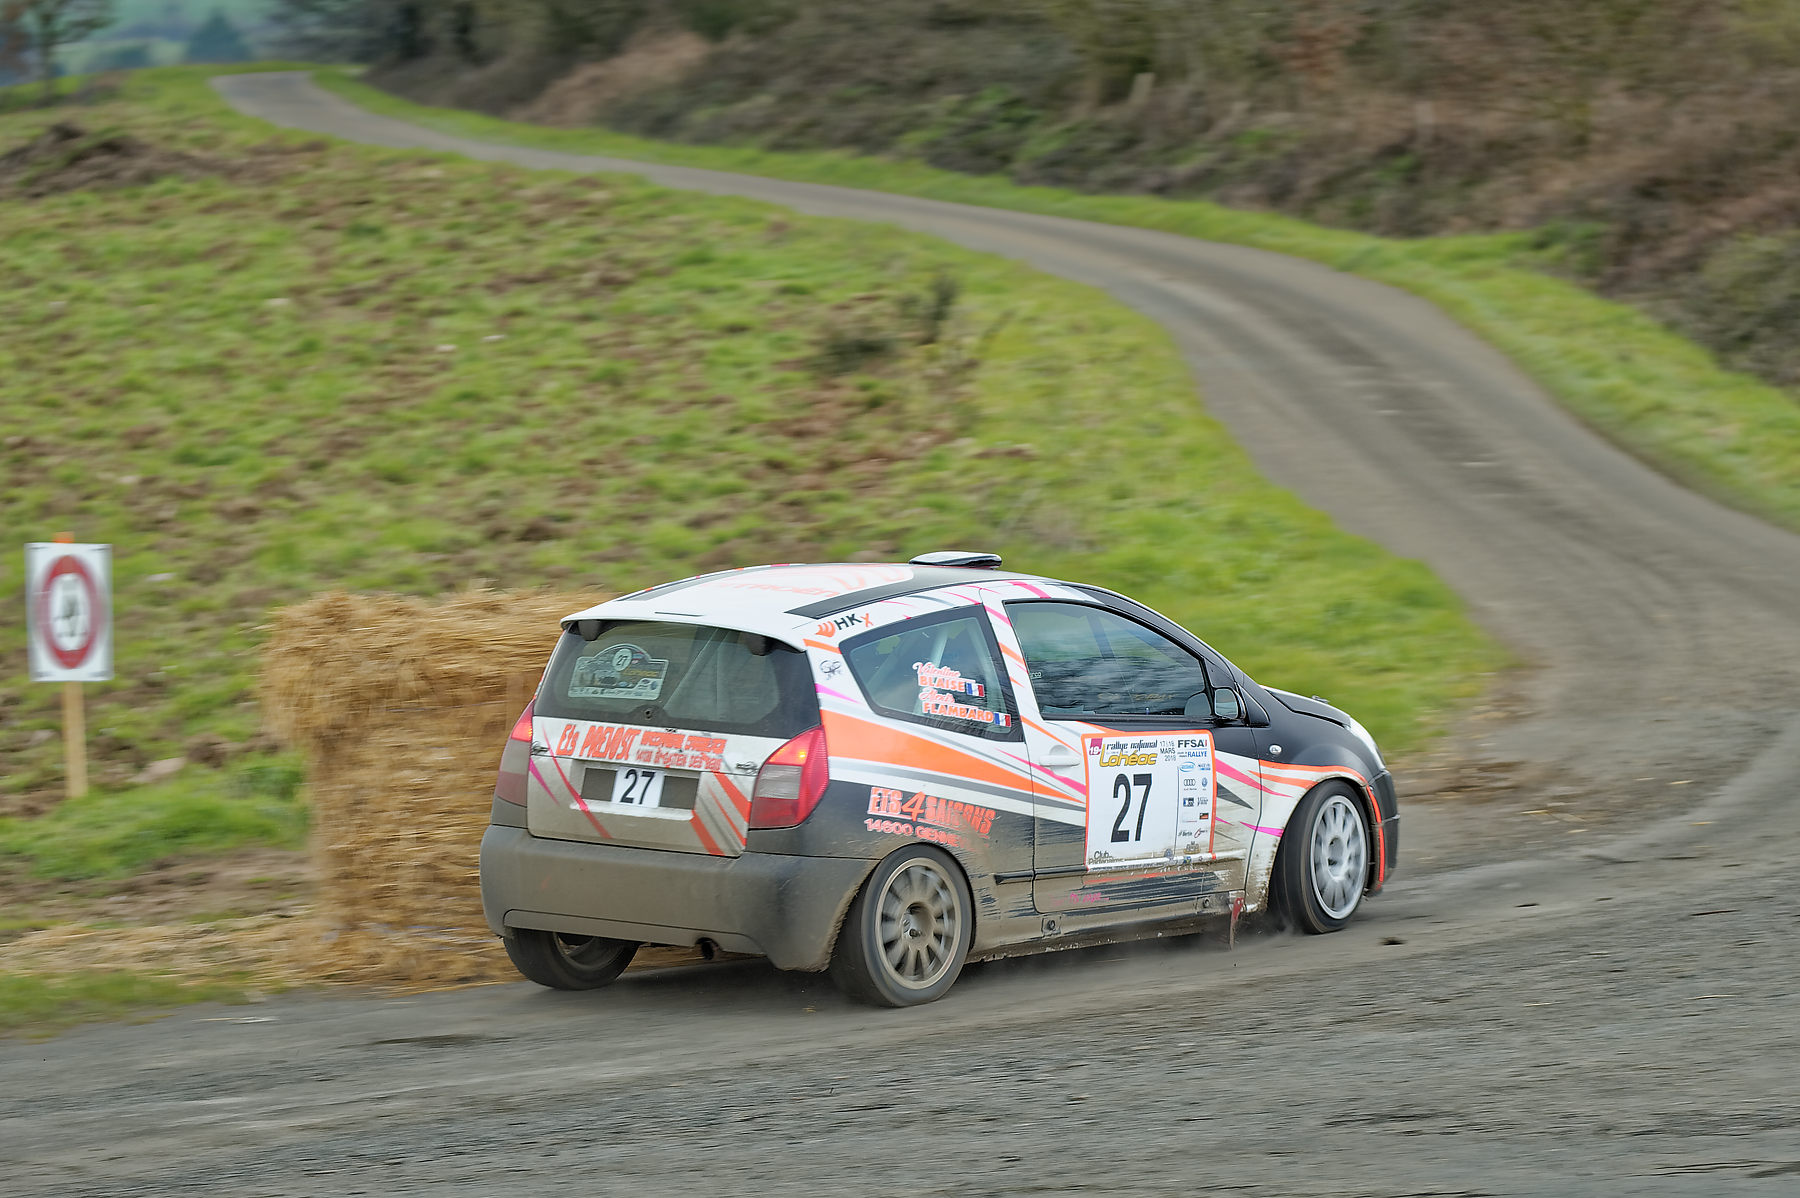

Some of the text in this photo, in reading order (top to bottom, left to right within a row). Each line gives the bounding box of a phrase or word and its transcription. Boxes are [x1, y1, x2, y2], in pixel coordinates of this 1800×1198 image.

[615, 654, 628, 669] 27
[919, 676, 965, 692] BLAISE
[922, 702, 994, 723] FLAMBARD
[1106, 739, 1158, 753] rallye national
[1178, 739, 1205, 749] FFSA
[1099, 743, 1158, 768] Lohéac
[619, 768, 656, 805] 27
[867, 787, 903, 815] ETS
[901, 791, 926, 822] 4
[1110, 773, 1153, 843] 27
[864, 818, 914, 836] 14600
[1093, 850, 1110, 859] Club
